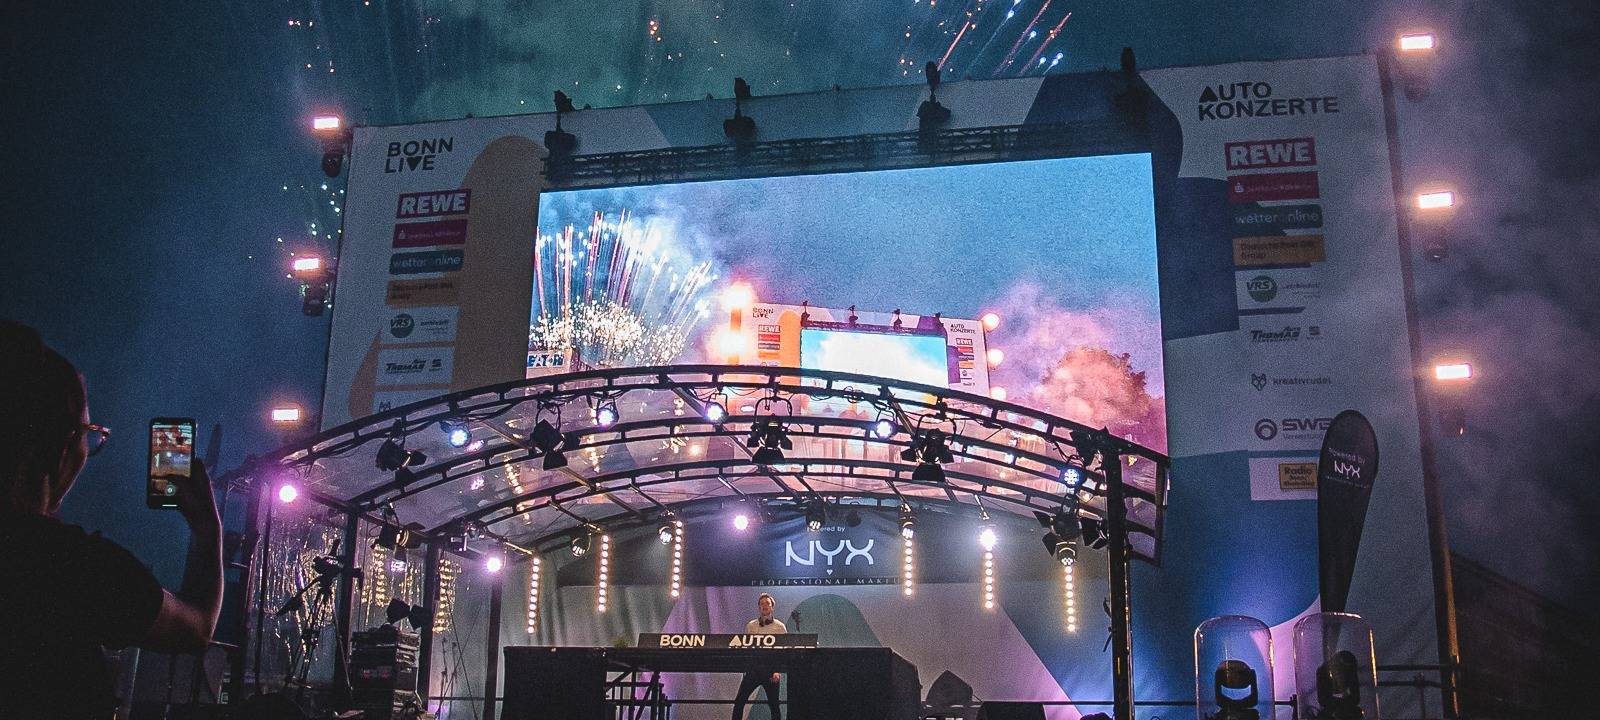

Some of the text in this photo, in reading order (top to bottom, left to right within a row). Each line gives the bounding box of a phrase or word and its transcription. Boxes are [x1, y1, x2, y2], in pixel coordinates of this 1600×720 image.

[1200, 82, 1272, 103] AUTO
[1198, 96, 1340, 121] KONZERTE
[387, 137, 453, 157] BONN
[1229, 142, 1312, 166] REWE
[384, 155, 436, 173] LIVE
[400, 192, 467, 214] REWE
[1246, 280, 1271, 291] VRS
[759, 325, 780, 333] REWE
[1334, 460, 1361, 479] NYX
[837, 525, 846, 533] by
[785, 538, 875, 567] NYX
[659, 634, 706, 647] BONN
[729, 634, 776, 647] AUTO
